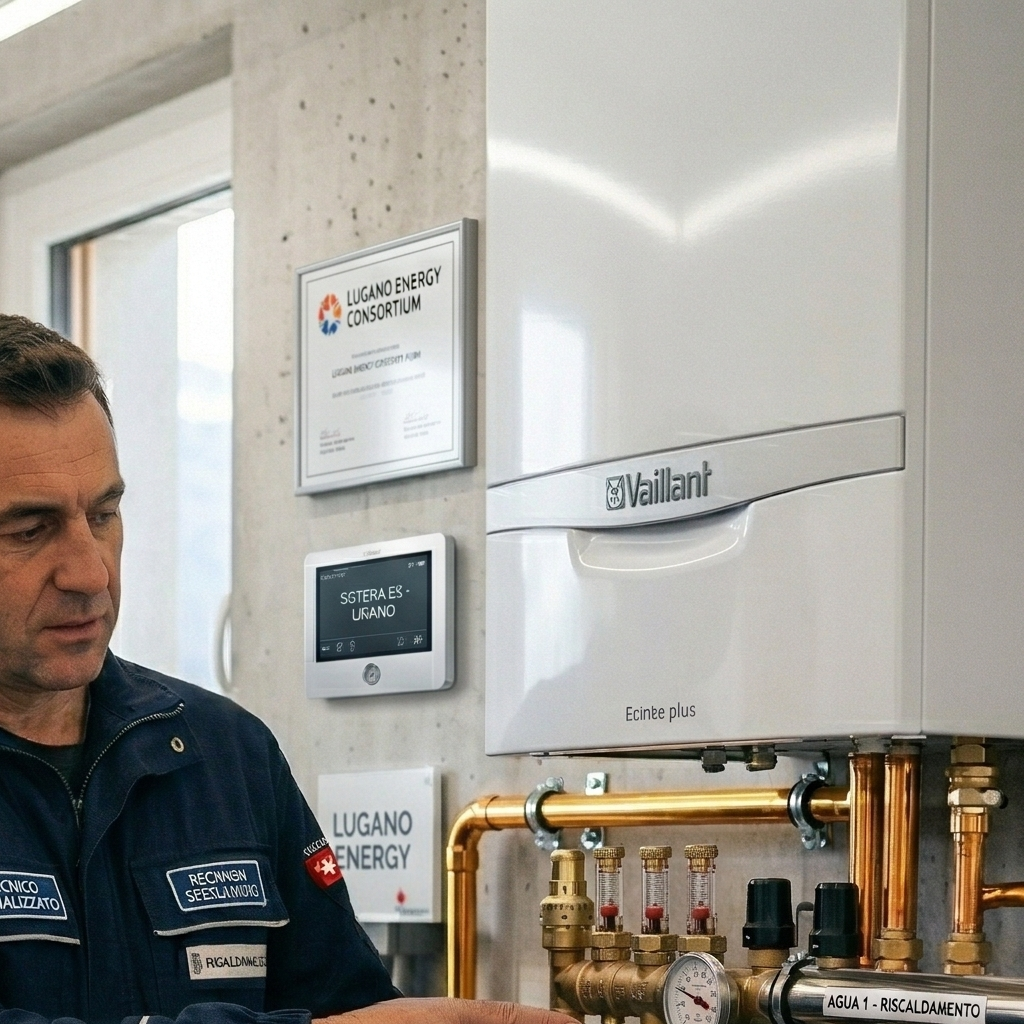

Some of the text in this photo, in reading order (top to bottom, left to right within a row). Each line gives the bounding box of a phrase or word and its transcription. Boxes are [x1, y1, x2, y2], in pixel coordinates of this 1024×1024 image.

[347, 265, 442, 307] LUGANO ENERGY
[347, 294, 422, 328] CONSORTIUM
[626, 461, 712, 507] Vaillant
[669, 702, 696, 723] plus
[333, 810, 413, 837] LUGANO
[335, 844, 411, 870] ENERGY
[827, 994, 860, 1011] AGUA
[863, 997, 869, 1010] 1
[880, 997, 981, 1019] RISCALDAMENTO
